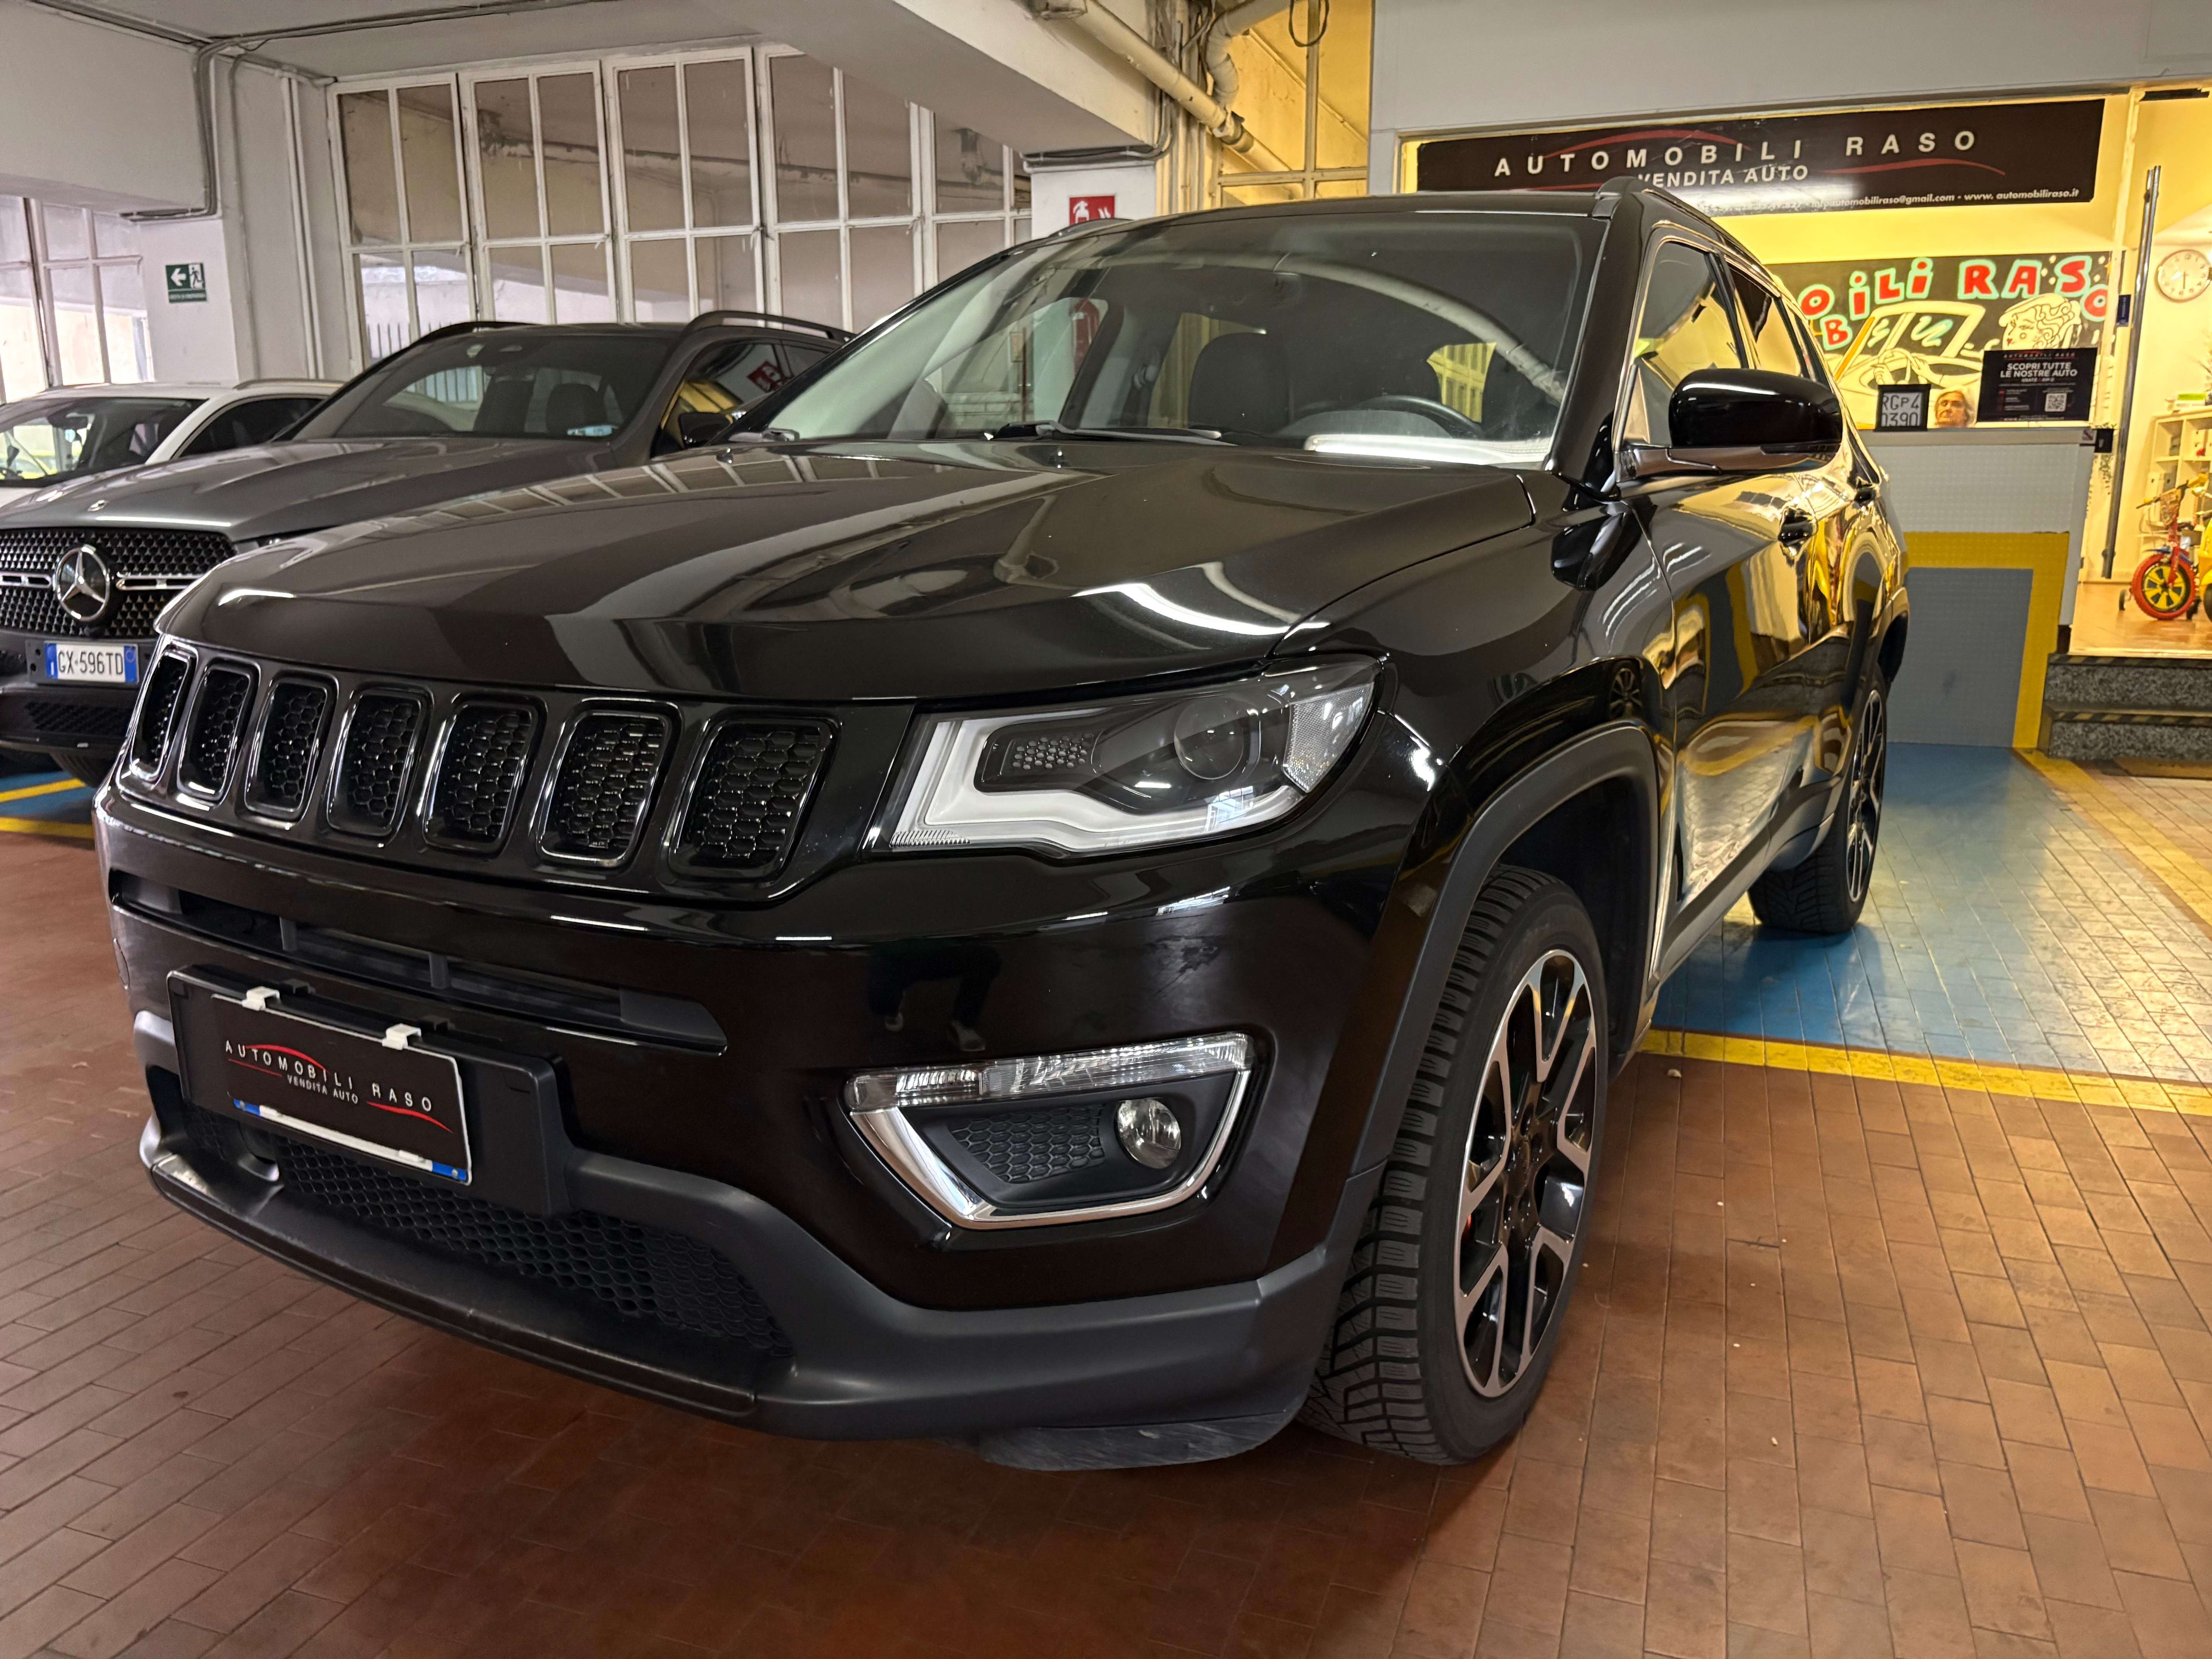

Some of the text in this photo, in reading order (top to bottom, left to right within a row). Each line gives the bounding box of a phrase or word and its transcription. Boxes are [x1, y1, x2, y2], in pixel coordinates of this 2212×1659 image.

[1494, 131, 1975, 177] AUTOMOBILI RASO
[1744, 165, 1808, 183] AUTO
[1996, 188, 2079, 199] automobiliraso.it
[2007, 362, 2071, 371] SCOPRI TUTTE
[2013, 370, 2051, 378] NOSTRE
[2052, 369, 2078, 377] AUTO
[225, 1040, 432, 1112] AUTOMOBILI RASO
[287, 1074, 358, 1104] VENDITA AUTO
